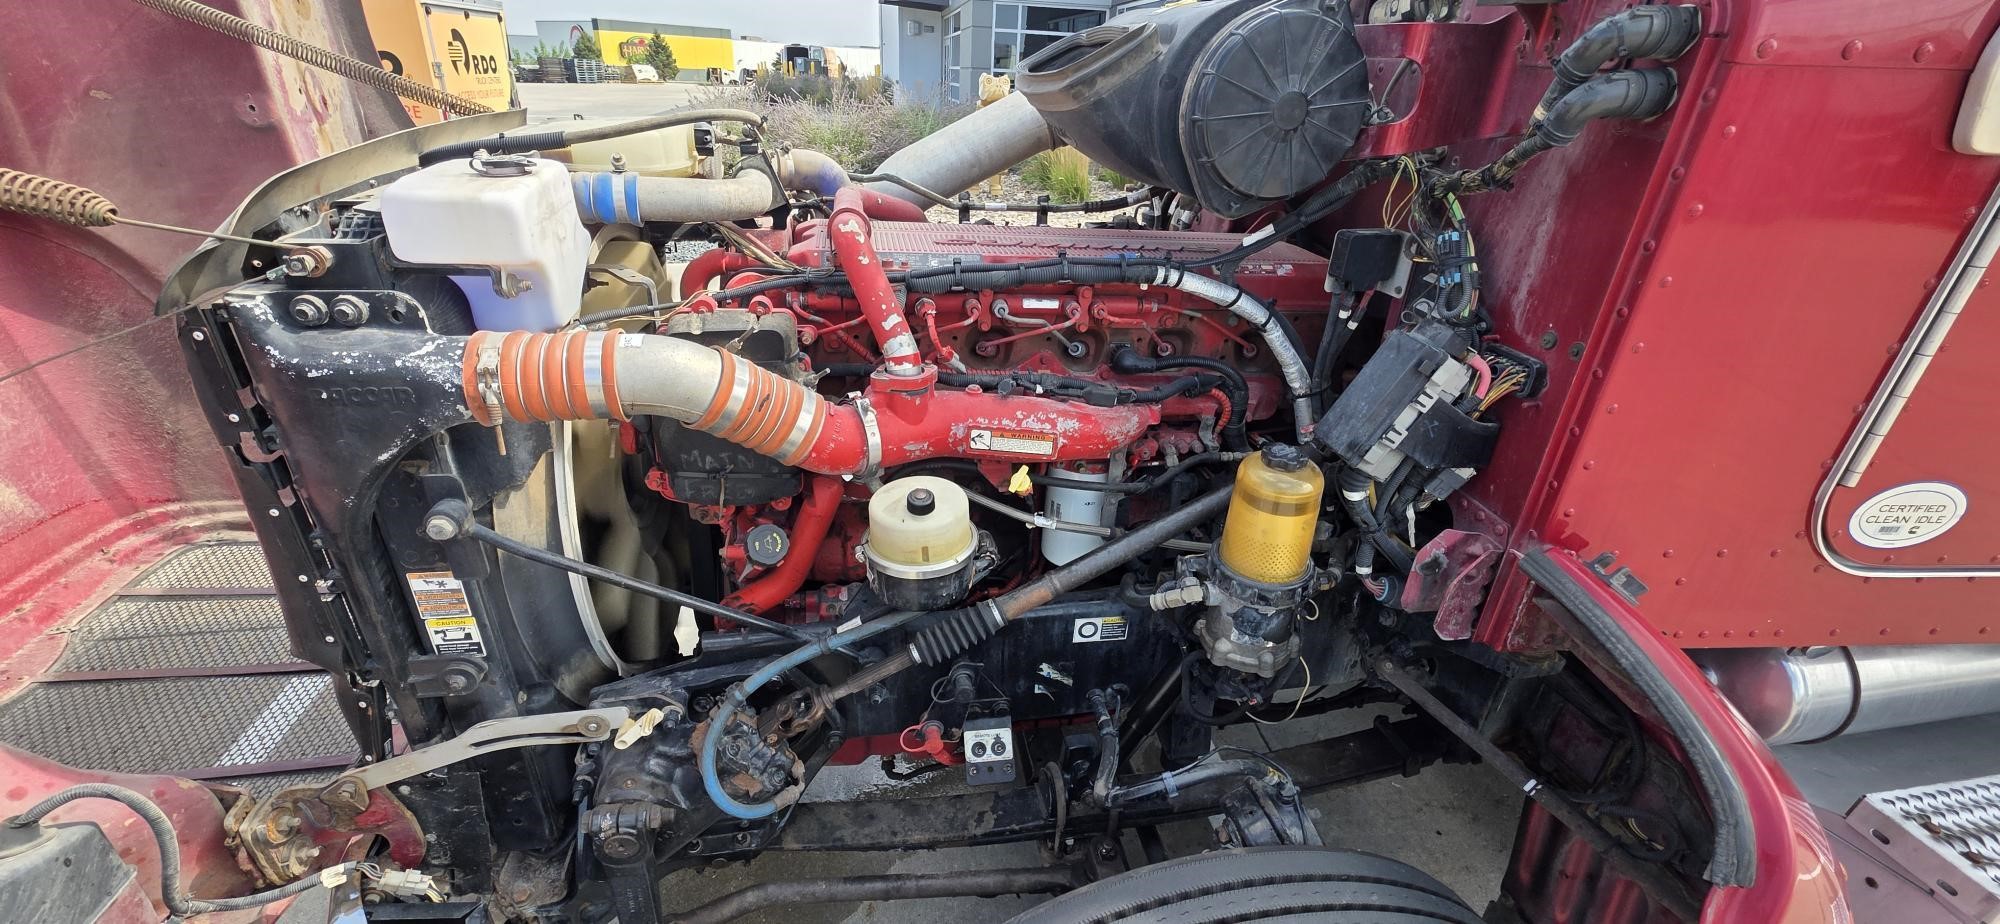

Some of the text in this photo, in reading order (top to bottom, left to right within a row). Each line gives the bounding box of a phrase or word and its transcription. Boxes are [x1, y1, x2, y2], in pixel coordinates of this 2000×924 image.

[472, 54, 497, 75] RDO
[1010, 433, 1046, 441] WARNING
[1878, 504, 1946, 513] CERTIFIED
[1865, 515, 1947, 524] CLEAN IDLE
